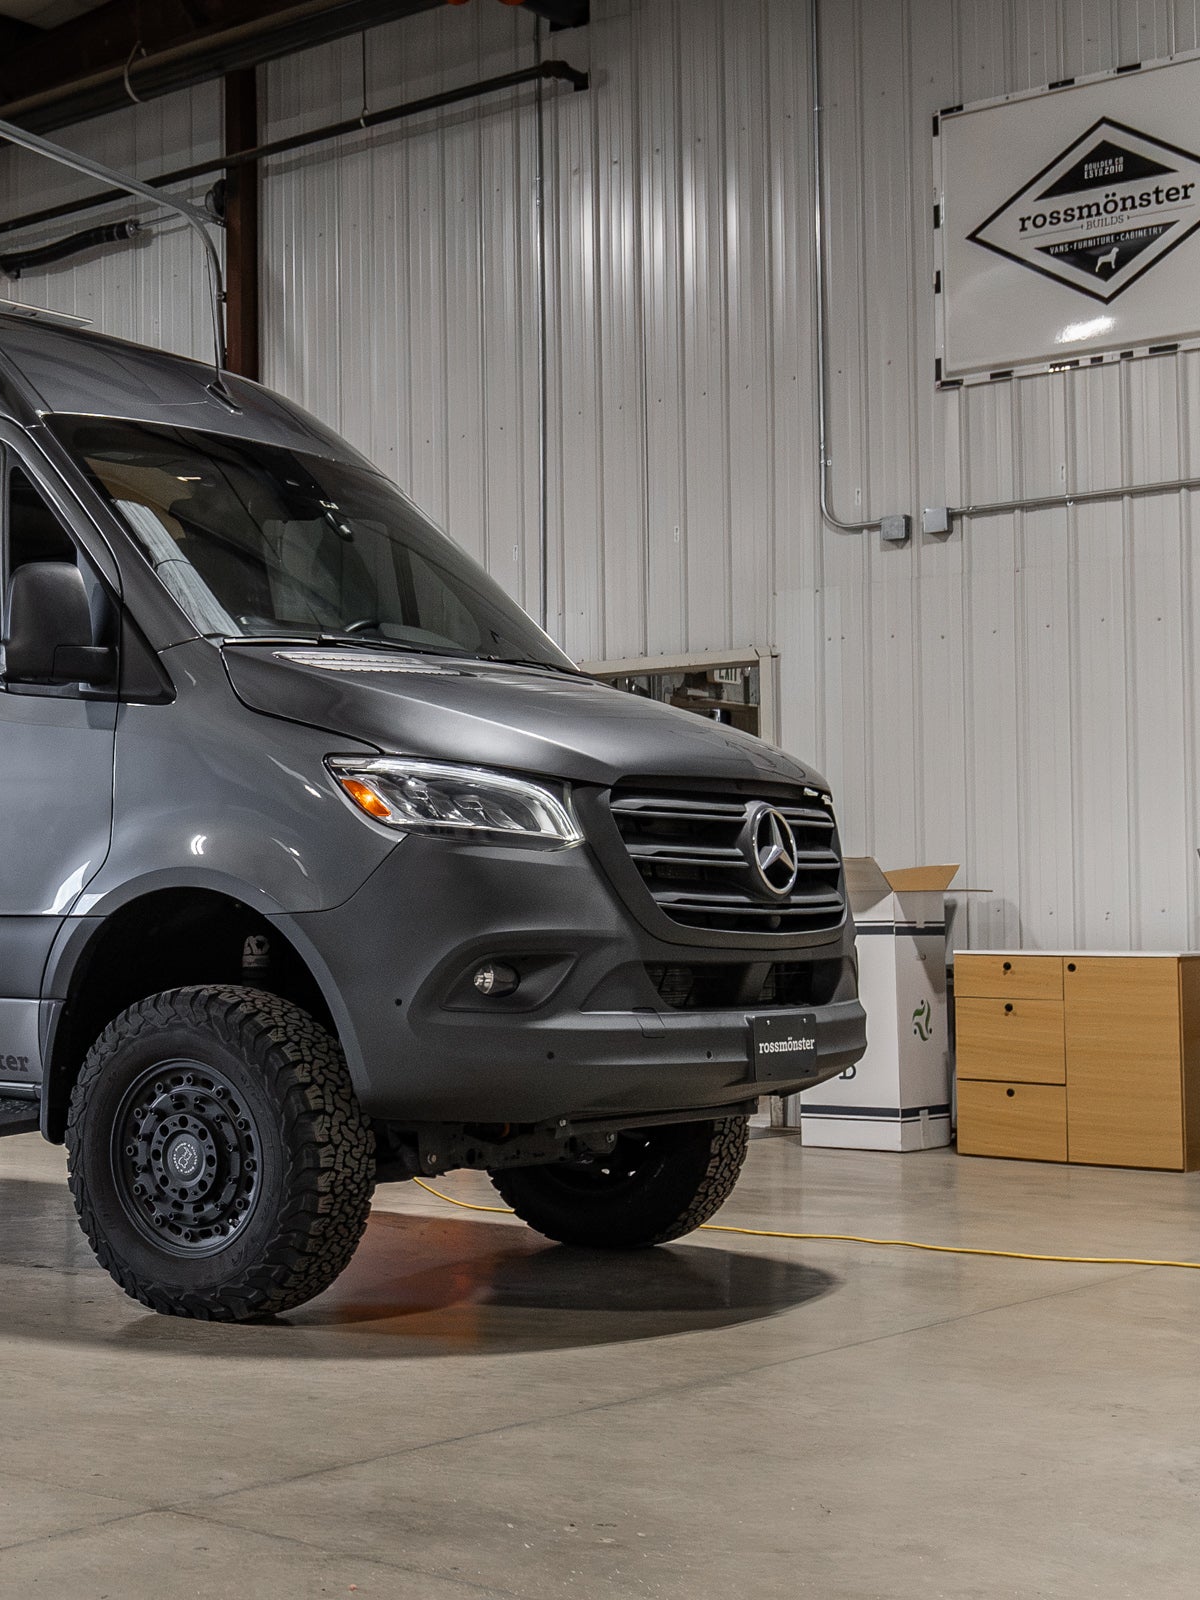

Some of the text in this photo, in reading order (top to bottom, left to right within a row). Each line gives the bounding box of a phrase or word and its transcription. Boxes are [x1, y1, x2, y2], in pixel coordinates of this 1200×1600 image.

[1084, 159, 1112, 171] BOULDER
[1104, 163, 1124, 175] 2010
[1019, 182, 1195, 232] rossmönster
[1085, 215, 1124, 230] BUILDS
[759, 1036, 815, 1053] rossmönster
